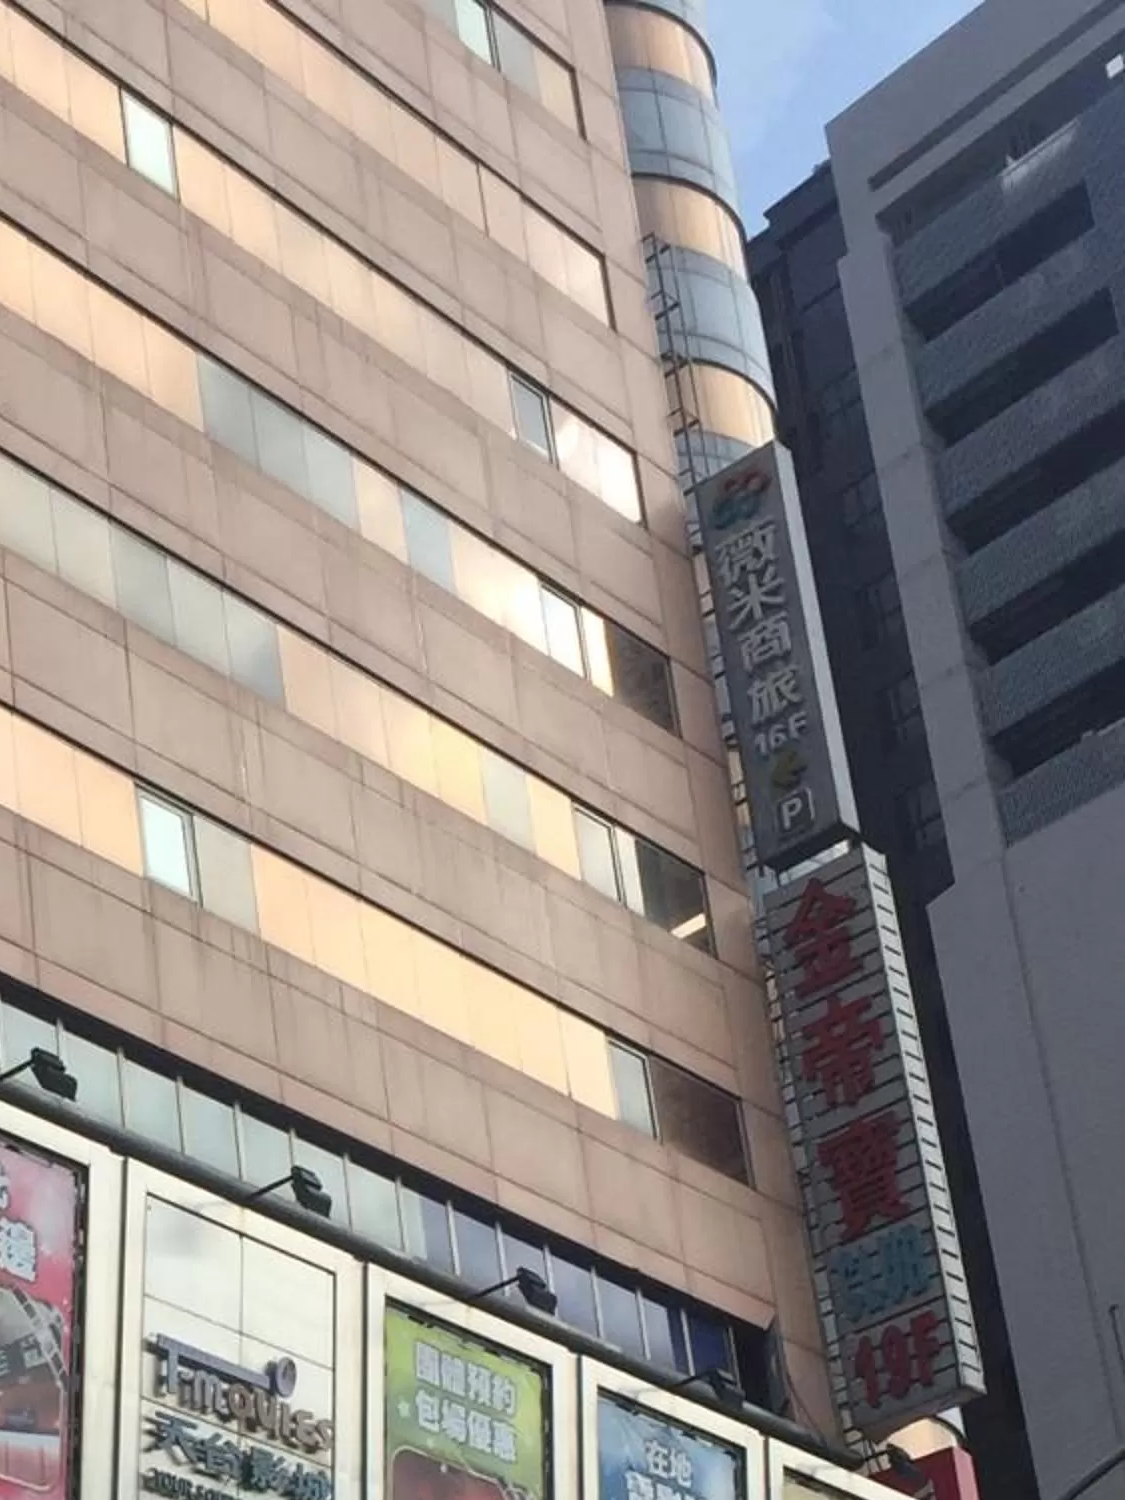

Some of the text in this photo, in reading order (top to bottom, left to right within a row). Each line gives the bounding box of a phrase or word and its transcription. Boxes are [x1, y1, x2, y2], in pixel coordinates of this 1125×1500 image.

[754, 713, 808, 754] 16F
[784, 877, 909, 1242] 金帝寶
[856, 1309, 941, 1409] 19F
[645, 1440, 693, 1486] 在地
